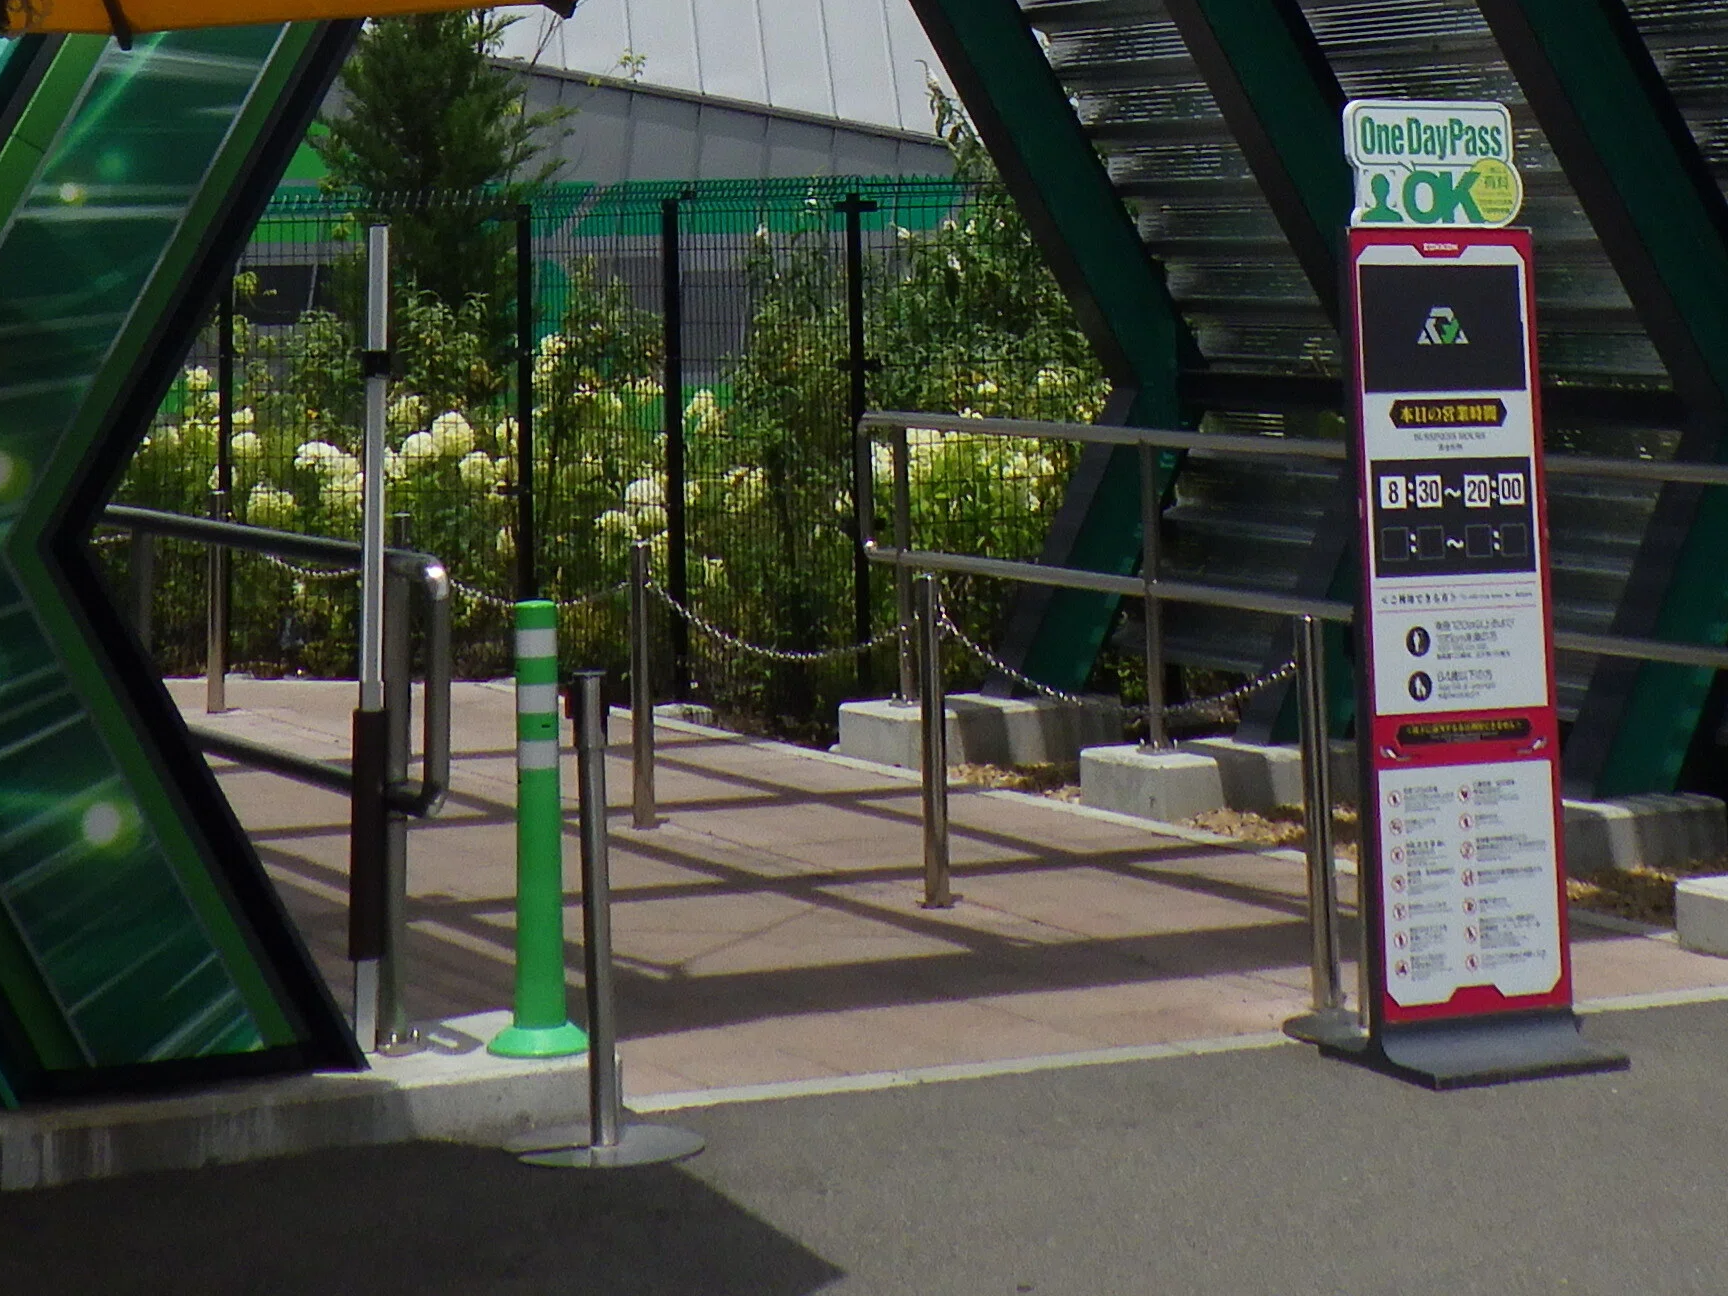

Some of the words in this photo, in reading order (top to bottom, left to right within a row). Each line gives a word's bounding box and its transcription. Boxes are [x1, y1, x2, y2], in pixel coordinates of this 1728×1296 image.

[1402, 169, 1486, 224] OK
[1399, 403, 1499, 425] 本日の営業時間
